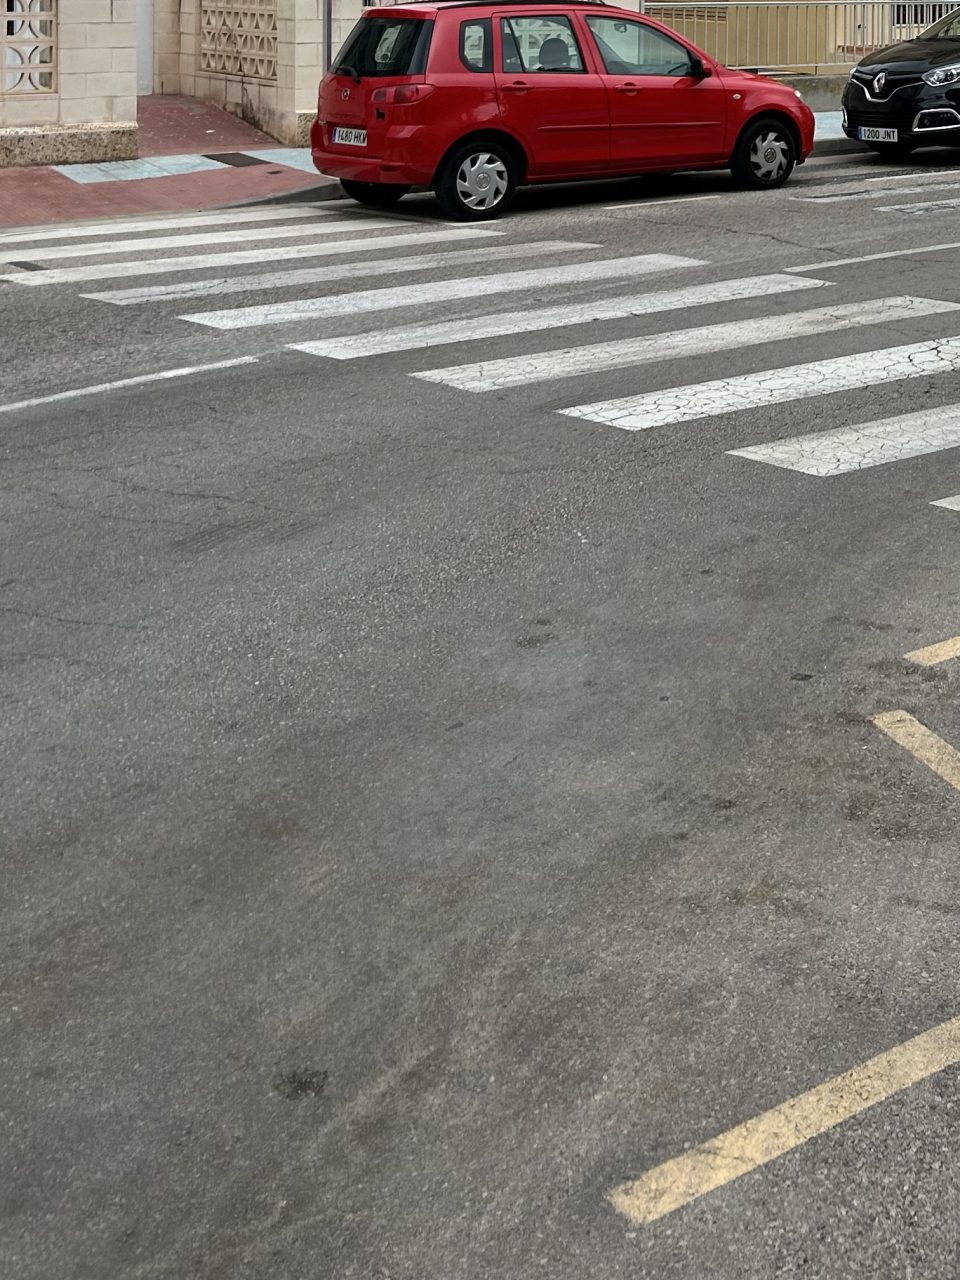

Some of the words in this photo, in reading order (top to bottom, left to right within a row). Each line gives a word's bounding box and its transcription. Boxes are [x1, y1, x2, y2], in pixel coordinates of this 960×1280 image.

[337, 129, 353, 143] 1480
[863, 128, 880, 140] 1200
[881, 129, 896, 140] JNT
